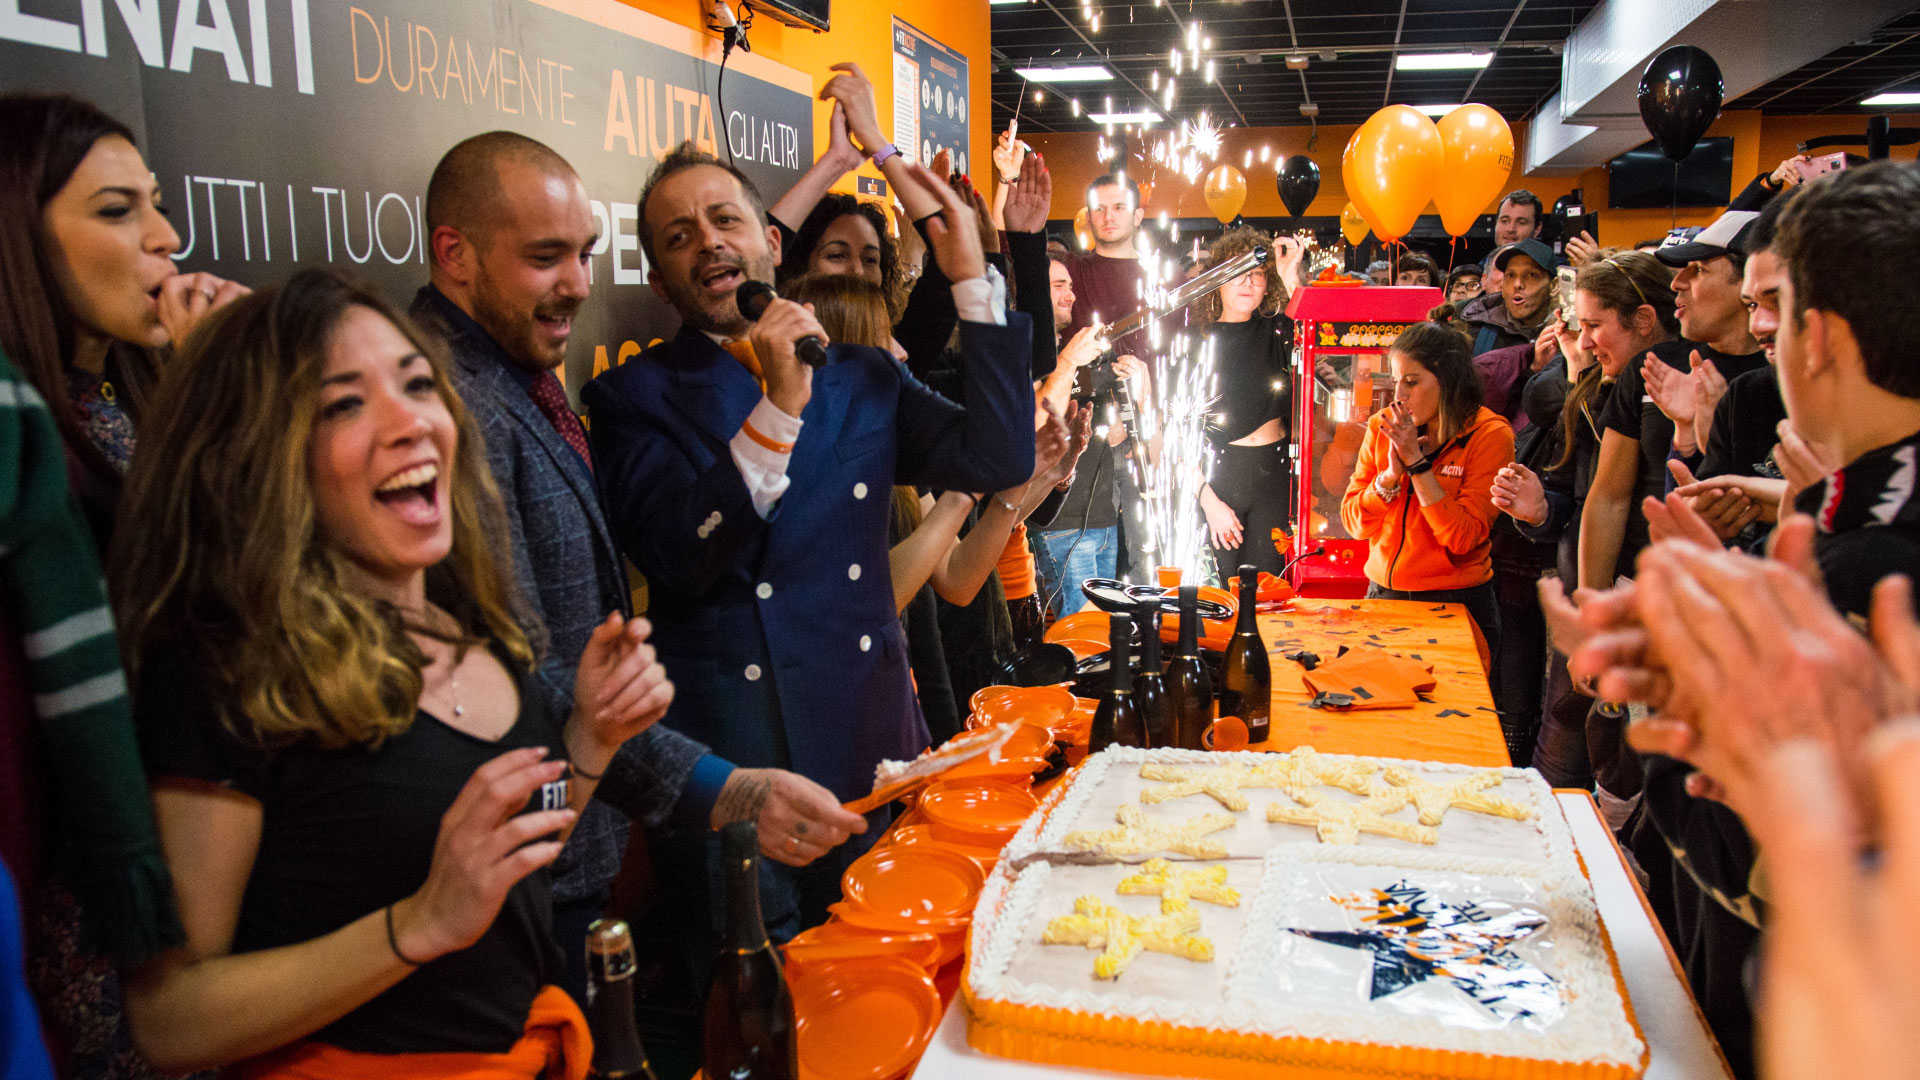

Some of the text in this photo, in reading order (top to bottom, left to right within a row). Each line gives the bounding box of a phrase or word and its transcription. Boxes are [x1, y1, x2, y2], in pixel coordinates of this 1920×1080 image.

[350, 6, 576, 126] DURAMENTE
[604, 69, 800, 171] AIUTA GLI ALTRI
[166, 174, 424, 265] UTTI I TUOI
